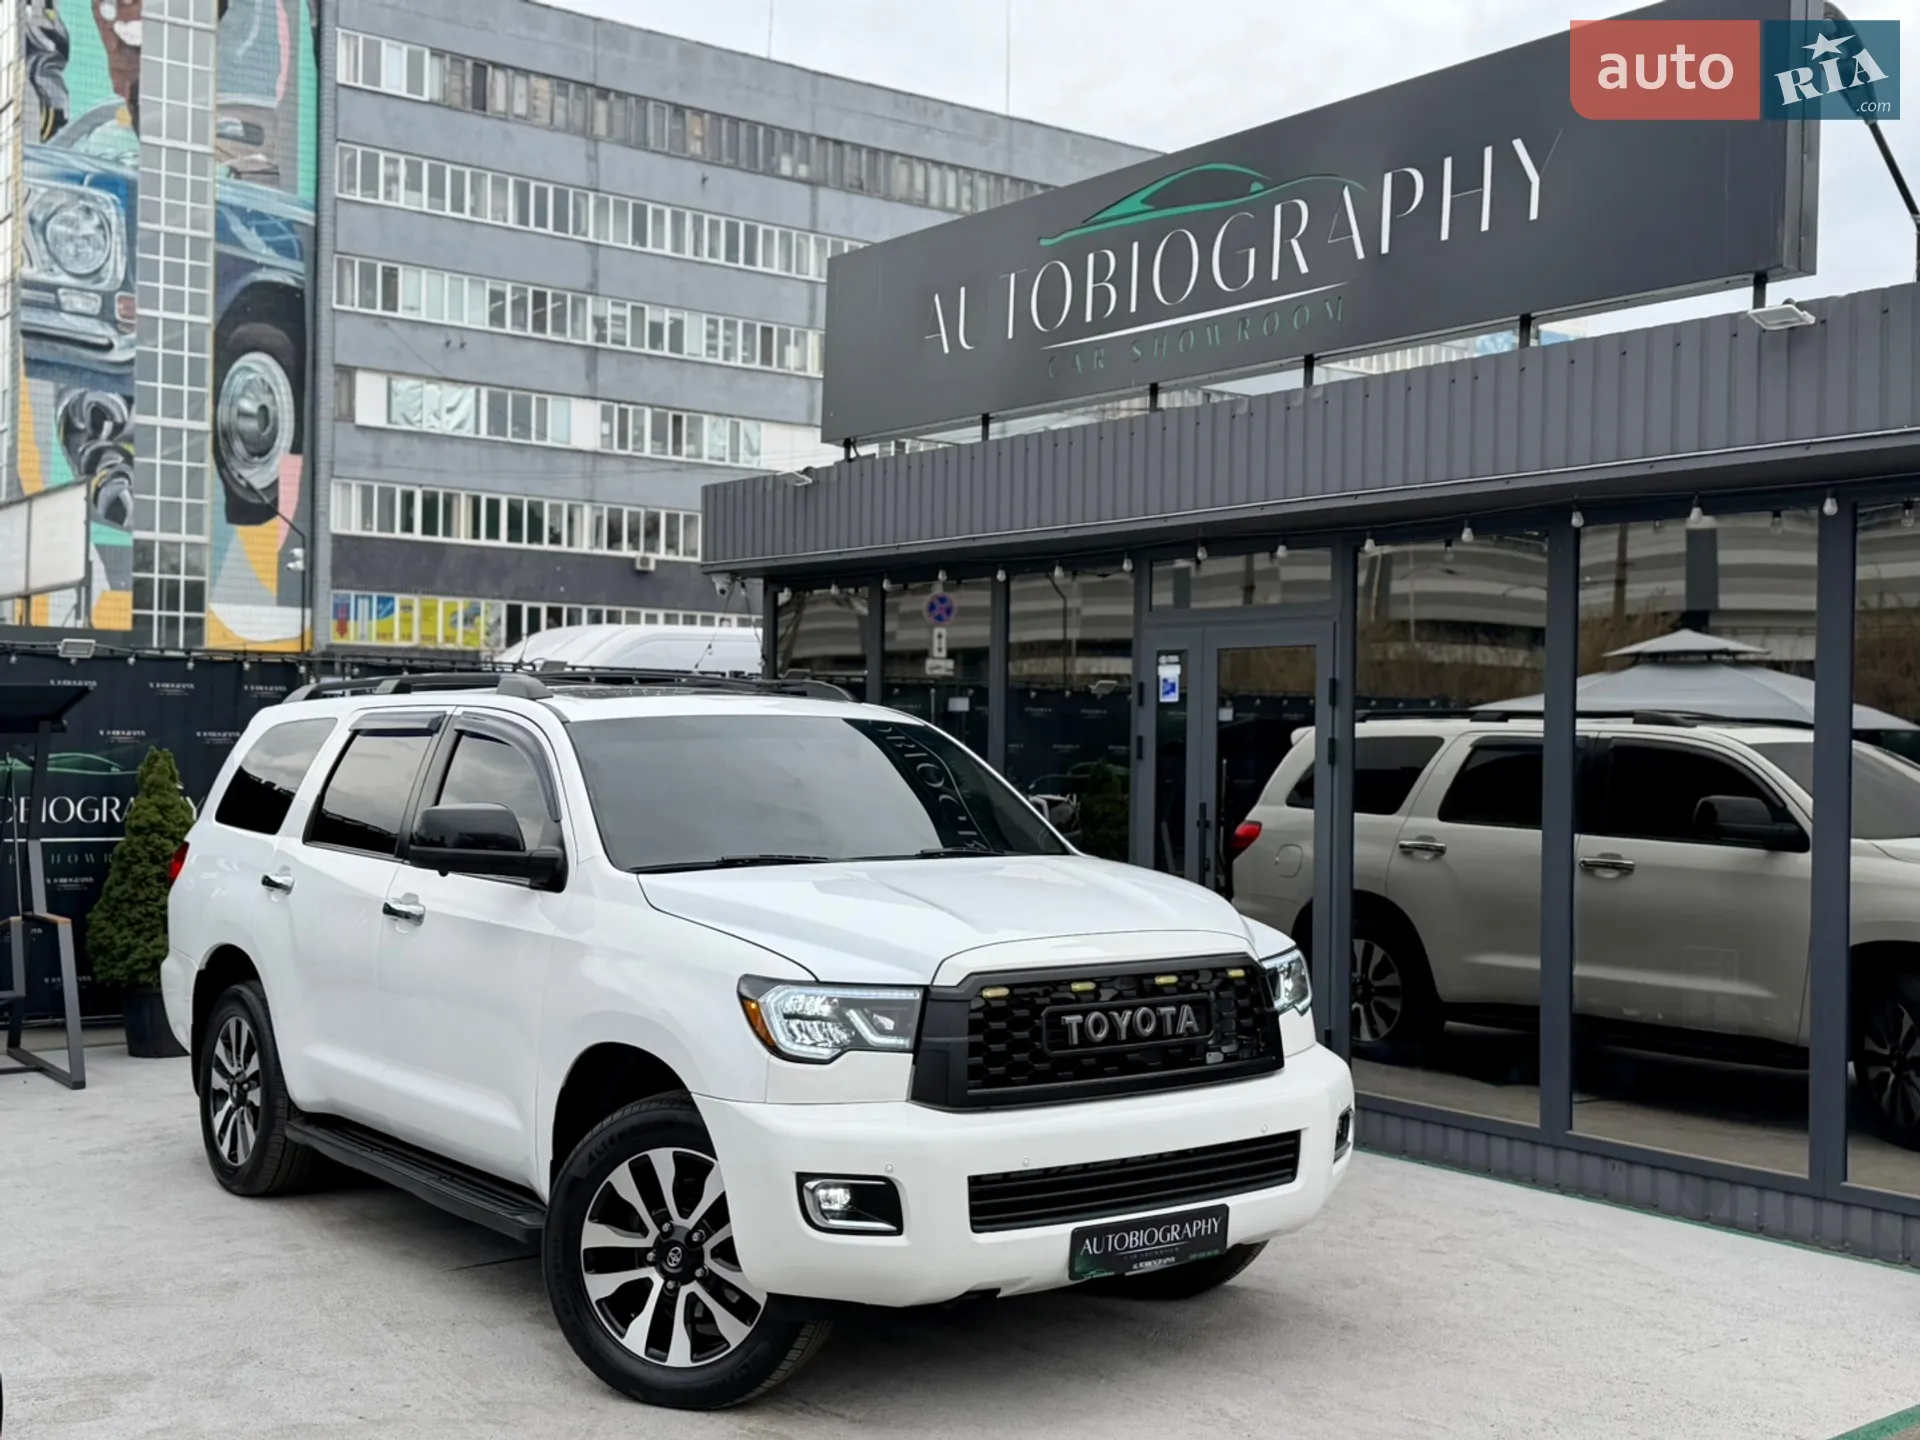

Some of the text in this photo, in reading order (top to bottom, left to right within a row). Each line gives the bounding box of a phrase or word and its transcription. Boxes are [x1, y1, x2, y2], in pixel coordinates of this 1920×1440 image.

[924, 128, 1563, 354] AUTOBIOGRAPHY
[1047, 296, 1343, 379] CAR SHOWROOM
[1061, 1004, 1199, 1045] TOYOTA
[1079, 1216, 1222, 1256] AUTOBIOGRAPHY
